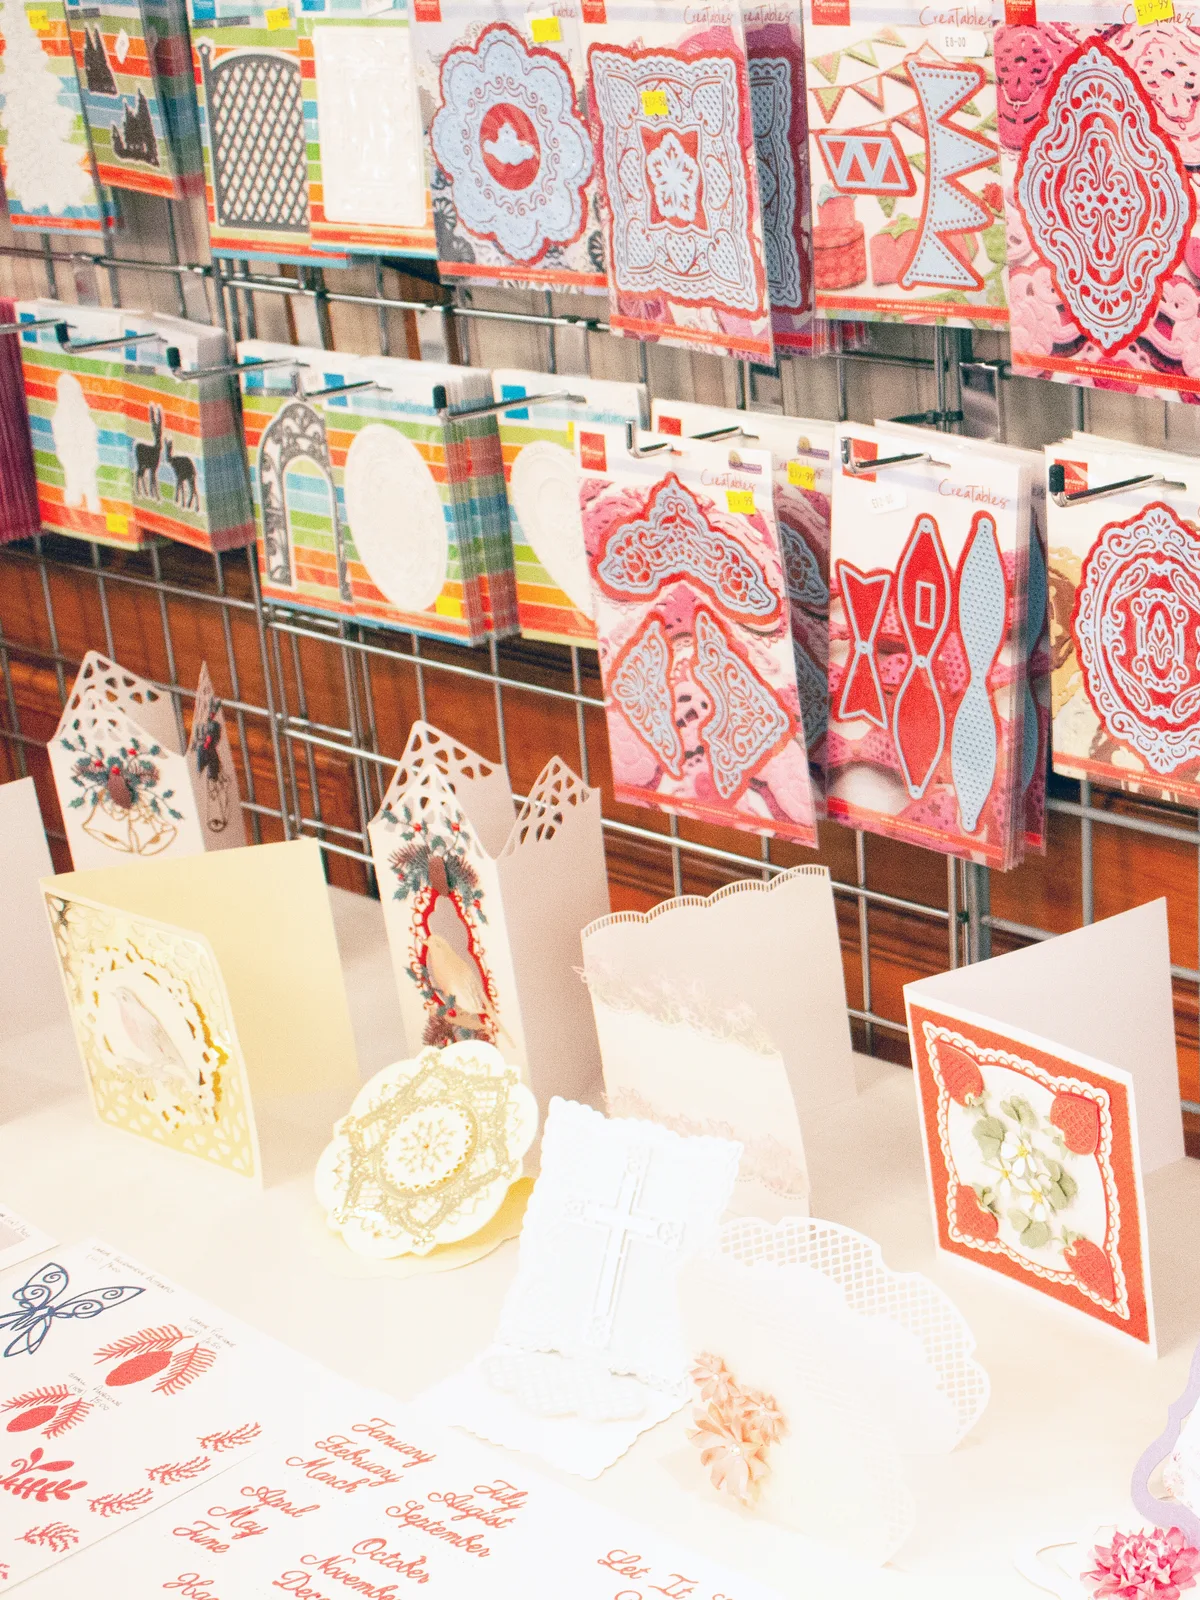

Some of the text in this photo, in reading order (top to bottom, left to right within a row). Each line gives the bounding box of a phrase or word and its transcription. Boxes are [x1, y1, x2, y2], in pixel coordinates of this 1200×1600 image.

[743, 5, 793, 24] reaTables
[919, 6, 993, 28] CreaTables
[938, 478, 1011, 509] CreaTables
[351, 1417, 437, 1468] January
[285, 1456, 370, 1493] March
[315, 1435, 404, 1487] February
[240, 1486, 321, 1517] April
[427, 1492, 516, 1529] August
[473, 1479, 529, 1514] July
[172, 1520, 230, 1554] June
[207, 1505, 269, 1540] May
[385, 1500, 491, 1558] September
[300, 1555, 401, 1600] Novembe
[352, 1537, 430, 1584] October
[597, 1549, 651, 1579] Let
